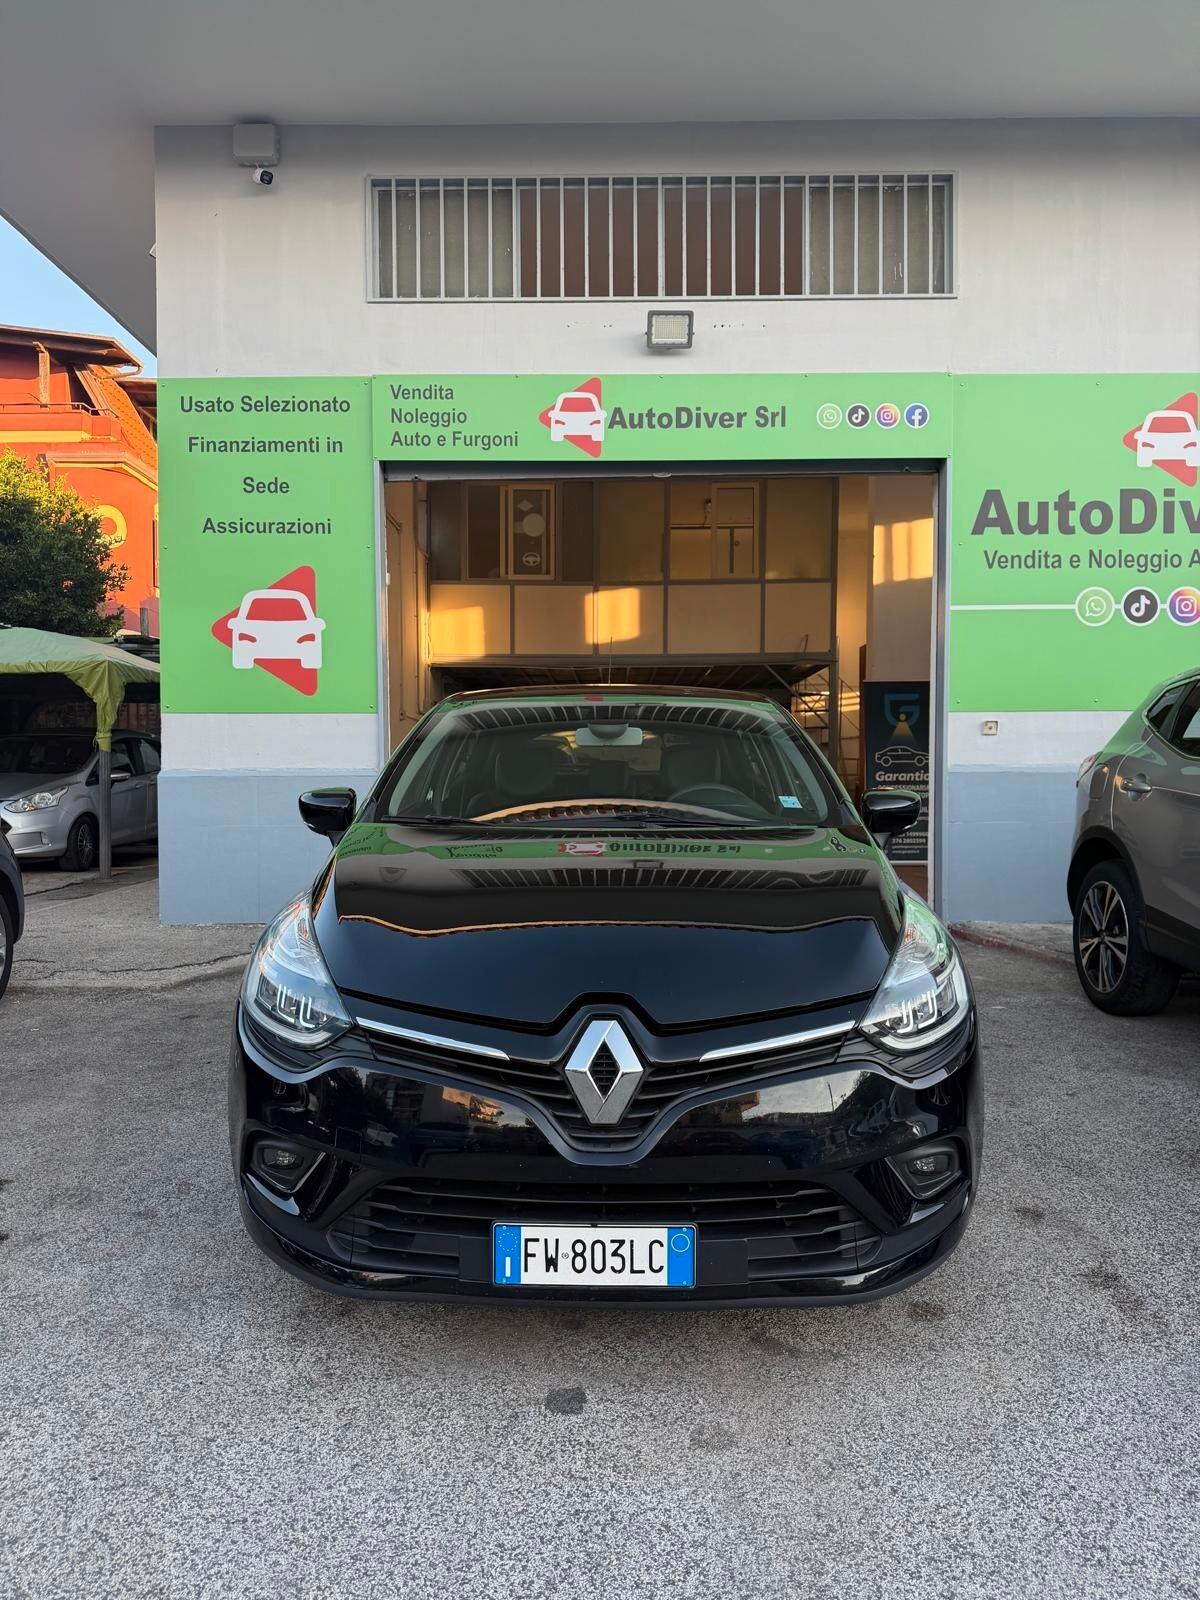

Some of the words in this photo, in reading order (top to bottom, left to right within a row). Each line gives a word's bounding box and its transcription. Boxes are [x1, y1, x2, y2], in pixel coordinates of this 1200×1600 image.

[390, 384, 454, 400] Vendita
[180, 395, 235, 413] Usato
[240, 395, 351, 413] Selezionato
[390, 408, 467, 427] Noleggio
[608, 406, 747, 429] AutoDiver
[755, 405, 786, 428] Srl
[188, 436, 320, 453] Finanziamenti
[326, 436, 343, 453] in
[390, 431, 431, 446] Auto
[437, 434, 446, 446] e
[452, 431, 518, 451] Furgoni
[242, 476, 290, 493] Sede
[202, 517, 332, 534] Assicurazioni
[984, 549, 1062, 569] Vendita
[1069, 553, 1081, 569] e
[1088, 549, 1182, 573] Noleggio
[523, 1238, 560, 1273] FW
[571, 1239, 665, 1274] 803LC
